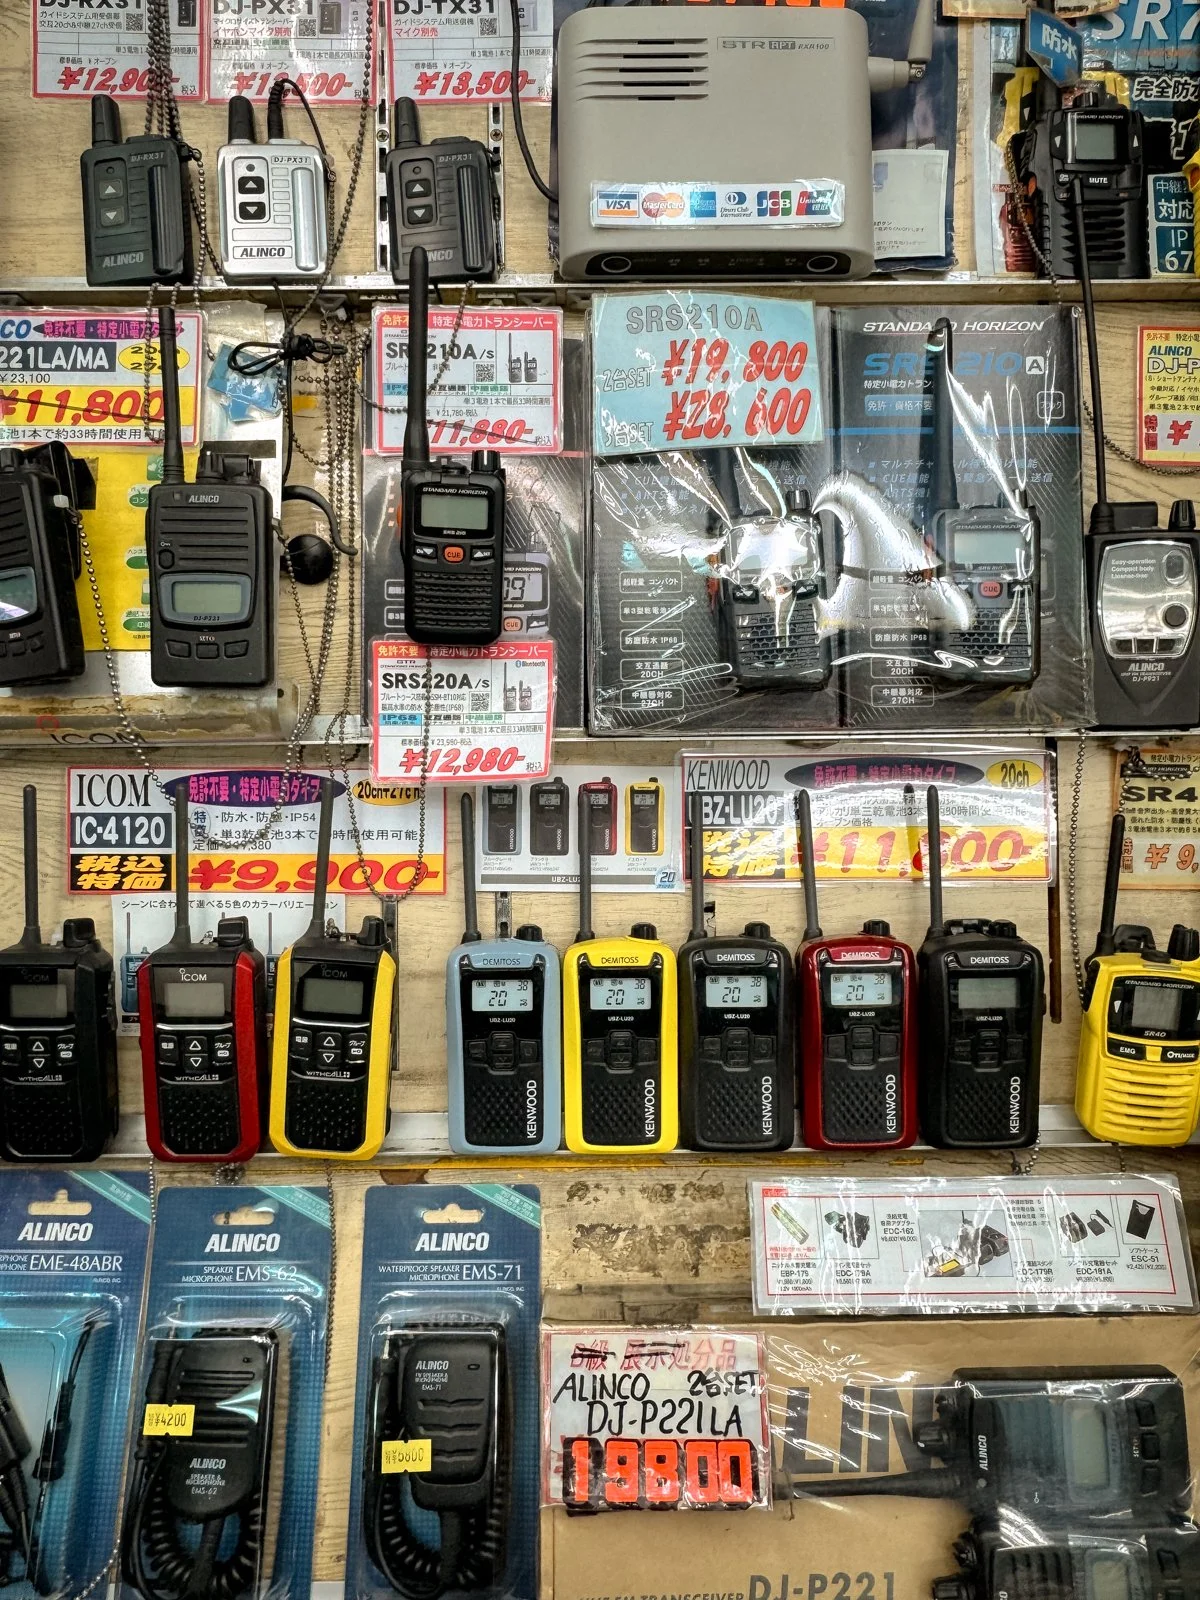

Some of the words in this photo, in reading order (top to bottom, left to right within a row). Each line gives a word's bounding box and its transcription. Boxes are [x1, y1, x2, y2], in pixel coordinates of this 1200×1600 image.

[394, 0, 495, 15] DJ-TX31
[394, 27, 438, 37] マイク別売
[723, 41, 765, 49] STR
[1042, 24, 1077, 61] 防水
[57, 67, 180, 94] ¥12,90-
[414, 71, 536, 97] ¥13,500-
[273, 156, 309, 164] DJ-PX31
[606, 201, 631, 210] VISA
[643, 201, 684, 209] MasterCard
[757, 199, 790, 209] JCB
[1158, 199, 1194, 219] 対応
[1171, 229, 1188, 248] IP
[103, 252, 144, 267] ALINCO
[240, 248, 285, 258] ALINCO
[1165, 250, 1193, 271] 67
[626, 303, 763, 335] SRS210A
[963, 321, 1044, 331] HORIZON
[1149, 345, 1192, 356] ALINCO
[1026, 357, 1044, 373] A
[602, 366, 654, 393] 2台SET
[189, 495, 220, 503] ALINCO
[377, 647, 419, 657] 免許不要
[429, 646, 548, 657] 特定小電力トランシーバー
[1128, 662, 1165, 672] ALINCO
[400, 747, 526, 775] ¥12,980-
[526, 762, 543, 772] 税込
[686, 760, 771, 790] KENWOOD
[1001, 763, 1030, 788] 20ch
[76, 773, 152, 807] ICOM
[1125, 787, 1198, 802] SR4
[689, 795, 778, 825] BZ-LU20
[75, 815, 166, 845] IC-4120
[815, 818, 873, 826] オープン価格
[75, 855, 165, 872] 税込
[77, 873, 167, 890] 特価
[660, 872, 676, 882] 20
[482, 958, 521, 966] DEMITOSS
[717, 953, 755, 961] DEMITOSS
[841, 951, 880, 959] DEMITOSS
[846, 985, 865, 1001] 20
[1163, 982, 1195, 990] HORIZON
[488, 991, 508, 1006] 20
[605, 989, 625, 1005] 20
[722, 987, 741, 1003] 20
[526, 1079, 537, 1139] KENWOOD
[644, 1079, 655, 1137] KENWOOD
[762, 1076, 773, 1135] KENWOOD
[886, 1074, 896, 1134] KENWOOD
[1010, 1076, 1021, 1134] KENWOOD
[17, 1223, 93, 1242] ALINCO
[204, 1233, 281, 1252] ALINCO
[414, 1232, 490, 1252] ALINCO
[30, 1255, 123, 1272] EME-48ABR
[378, 1265, 429, 1273] WATERPROOF
[181, 1275, 233, 1283] MICROPHONE
[236, 1265, 297, 1282] EMS-62
[409, 1274, 460, 1282] MICROPHONE
[463, 1264, 522, 1281] EMS-71
[415, 1360, 449, 1371] ALINCO
[553, 1372, 650, 1404] ALINCO
[155, 1412, 187, 1428] ¥4200
[587, 1398, 743, 1437] DJ-P221LA
[978, 1434, 988, 1471] ALINCO
[189, 1457, 227, 1469] ALINCO
[570, 1439, 753, 1503] 19800
[749, 1571, 895, 1600] DJ-P221
